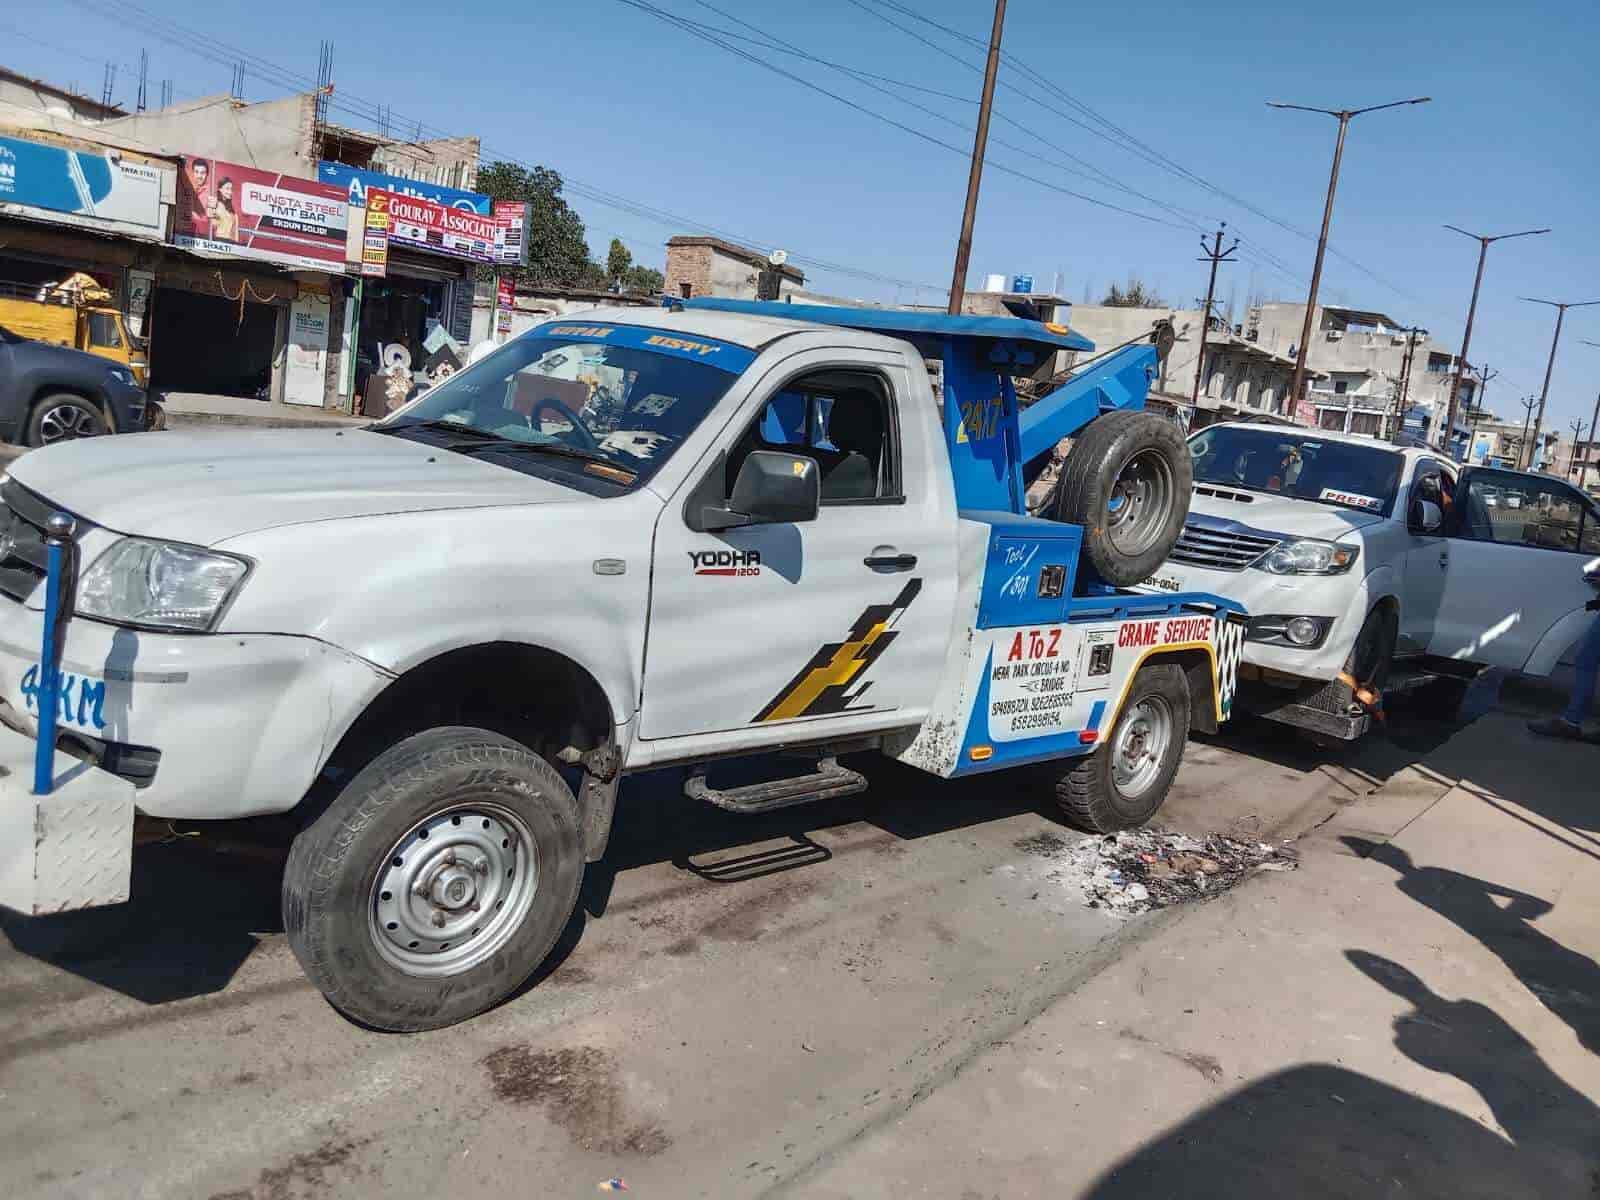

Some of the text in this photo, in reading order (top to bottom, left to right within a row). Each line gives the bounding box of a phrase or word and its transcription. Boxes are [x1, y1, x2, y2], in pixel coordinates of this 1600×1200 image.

[270, 204, 326, 223] TMT BAR
[304, 201, 344, 217] STEEL
[1327, 492, 1377, 508] PRESS
[688, 550, 761, 568] YODHA
[1118, 618, 1212, 648] CRANE SERVICE
[1008, 632, 1022, 662] A
[1047, 629, 1063, 658] Z
[1040, 676, 1065, 692] BRIDGE
